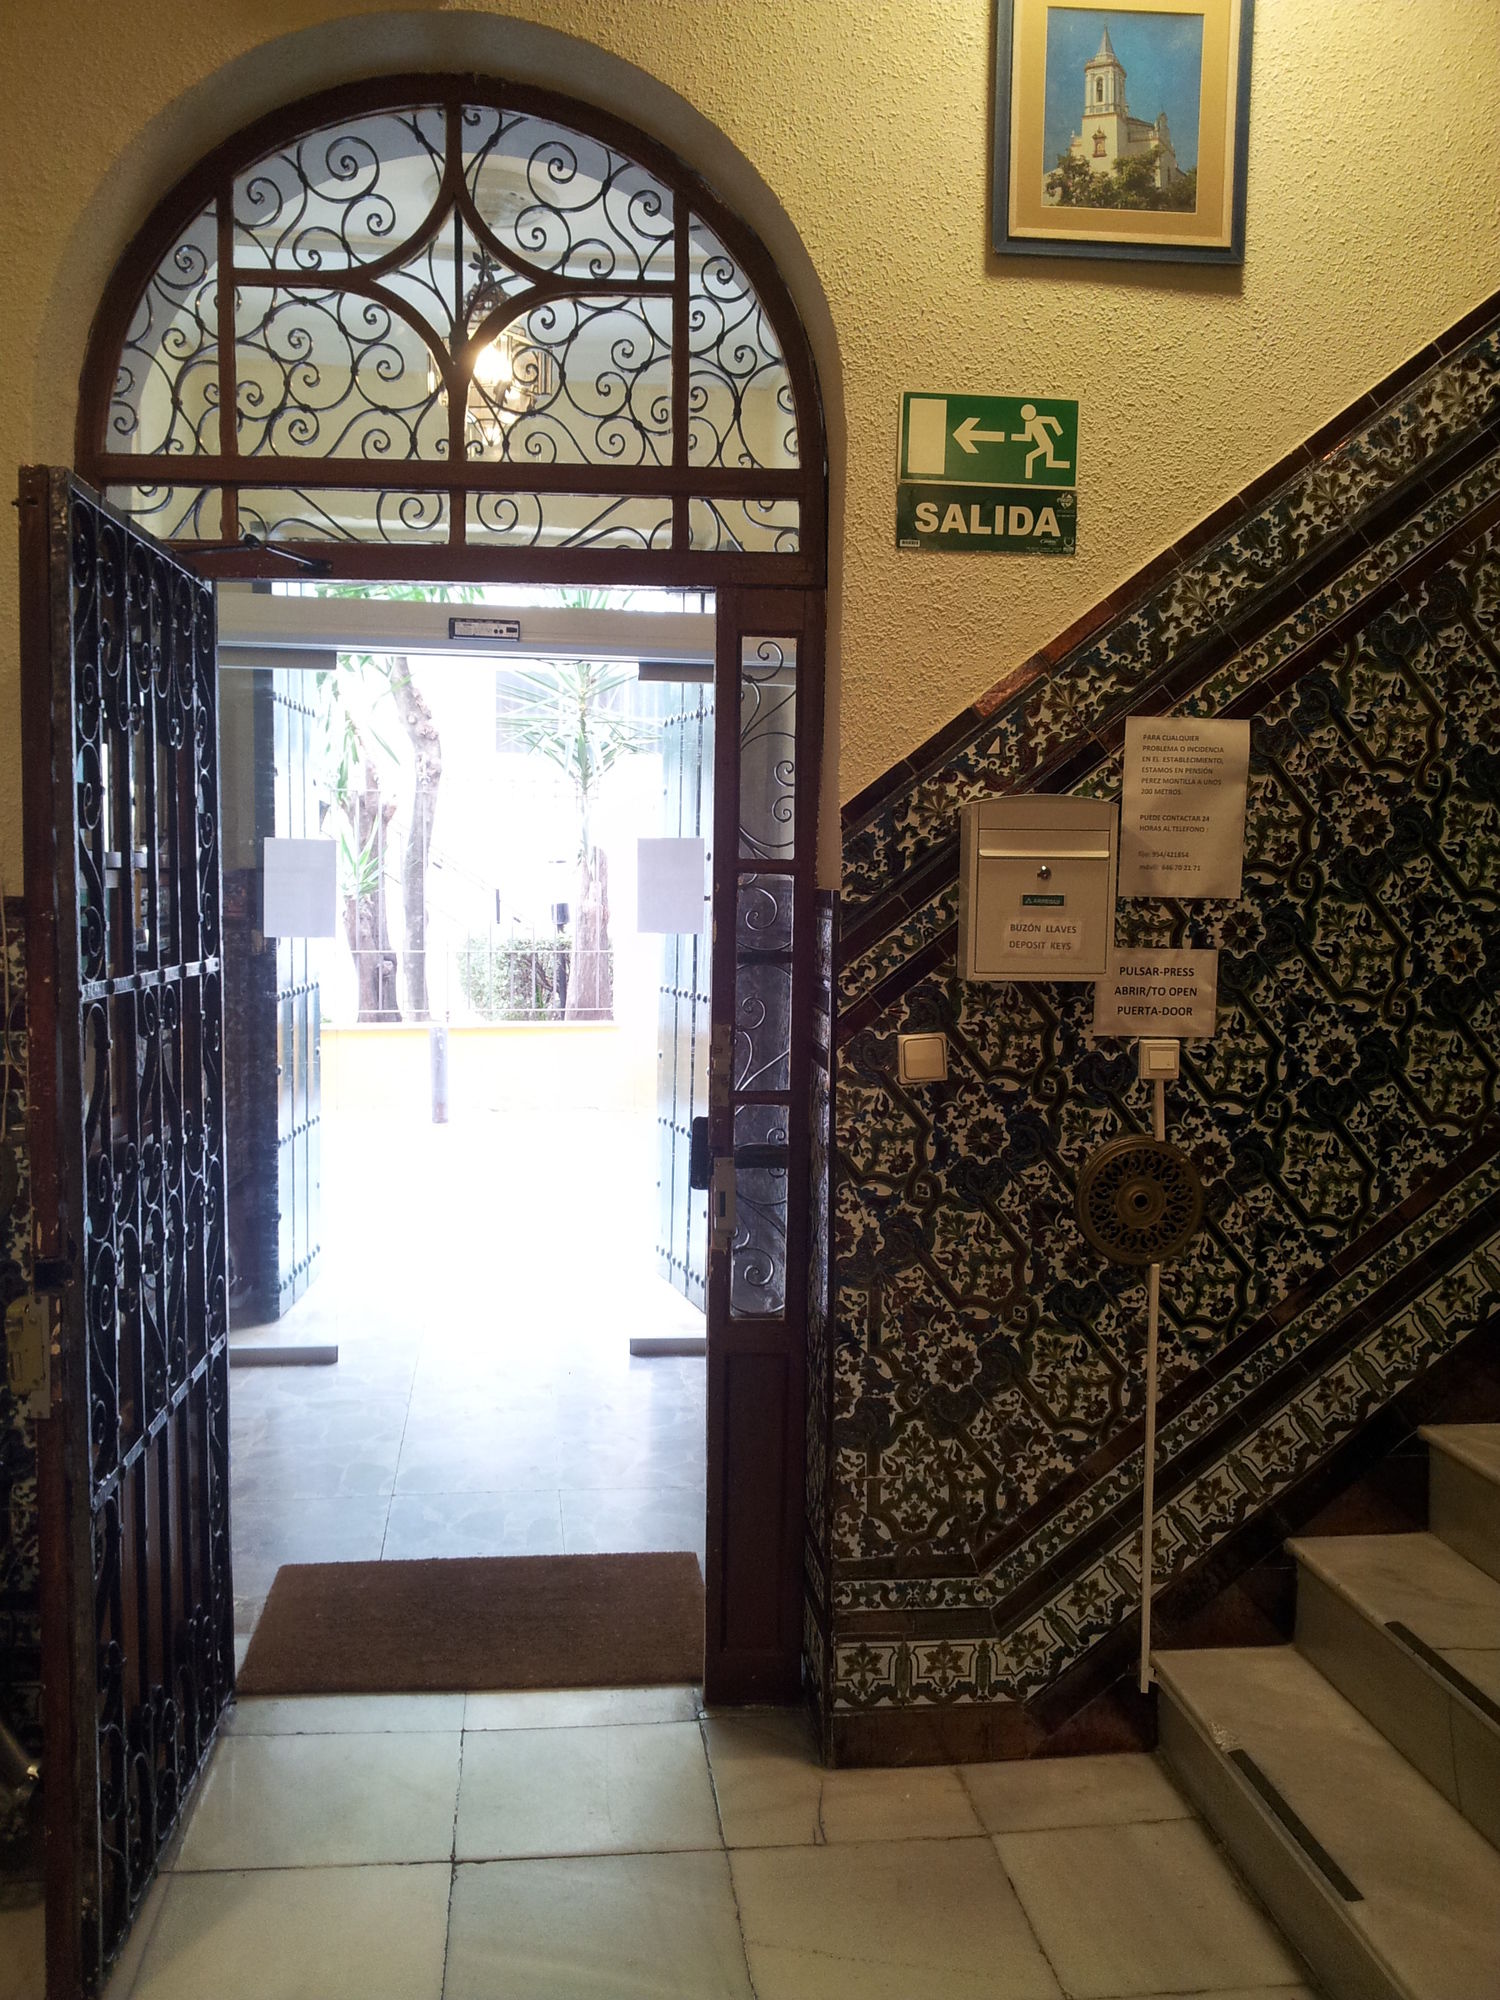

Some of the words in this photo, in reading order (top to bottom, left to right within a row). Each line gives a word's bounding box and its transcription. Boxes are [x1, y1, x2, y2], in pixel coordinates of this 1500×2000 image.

[915, 502, 1061, 536] SALIDA
[1010, 922, 1041, 932] BUZÓN
[1046, 925, 1076, 933] LLAVES
[1009, 941, 1045, 949] DEPOSIT
[1050, 942, 1071, 950] KEYS
[1120, 966, 1194, 976] PULSAR-PRESS
[1114, 986, 1166, 997] ABRIR/TO
[1169, 987, 1197, 996] OPEN
[1117, 1006, 1192, 1016] PUERTA-DOOR
